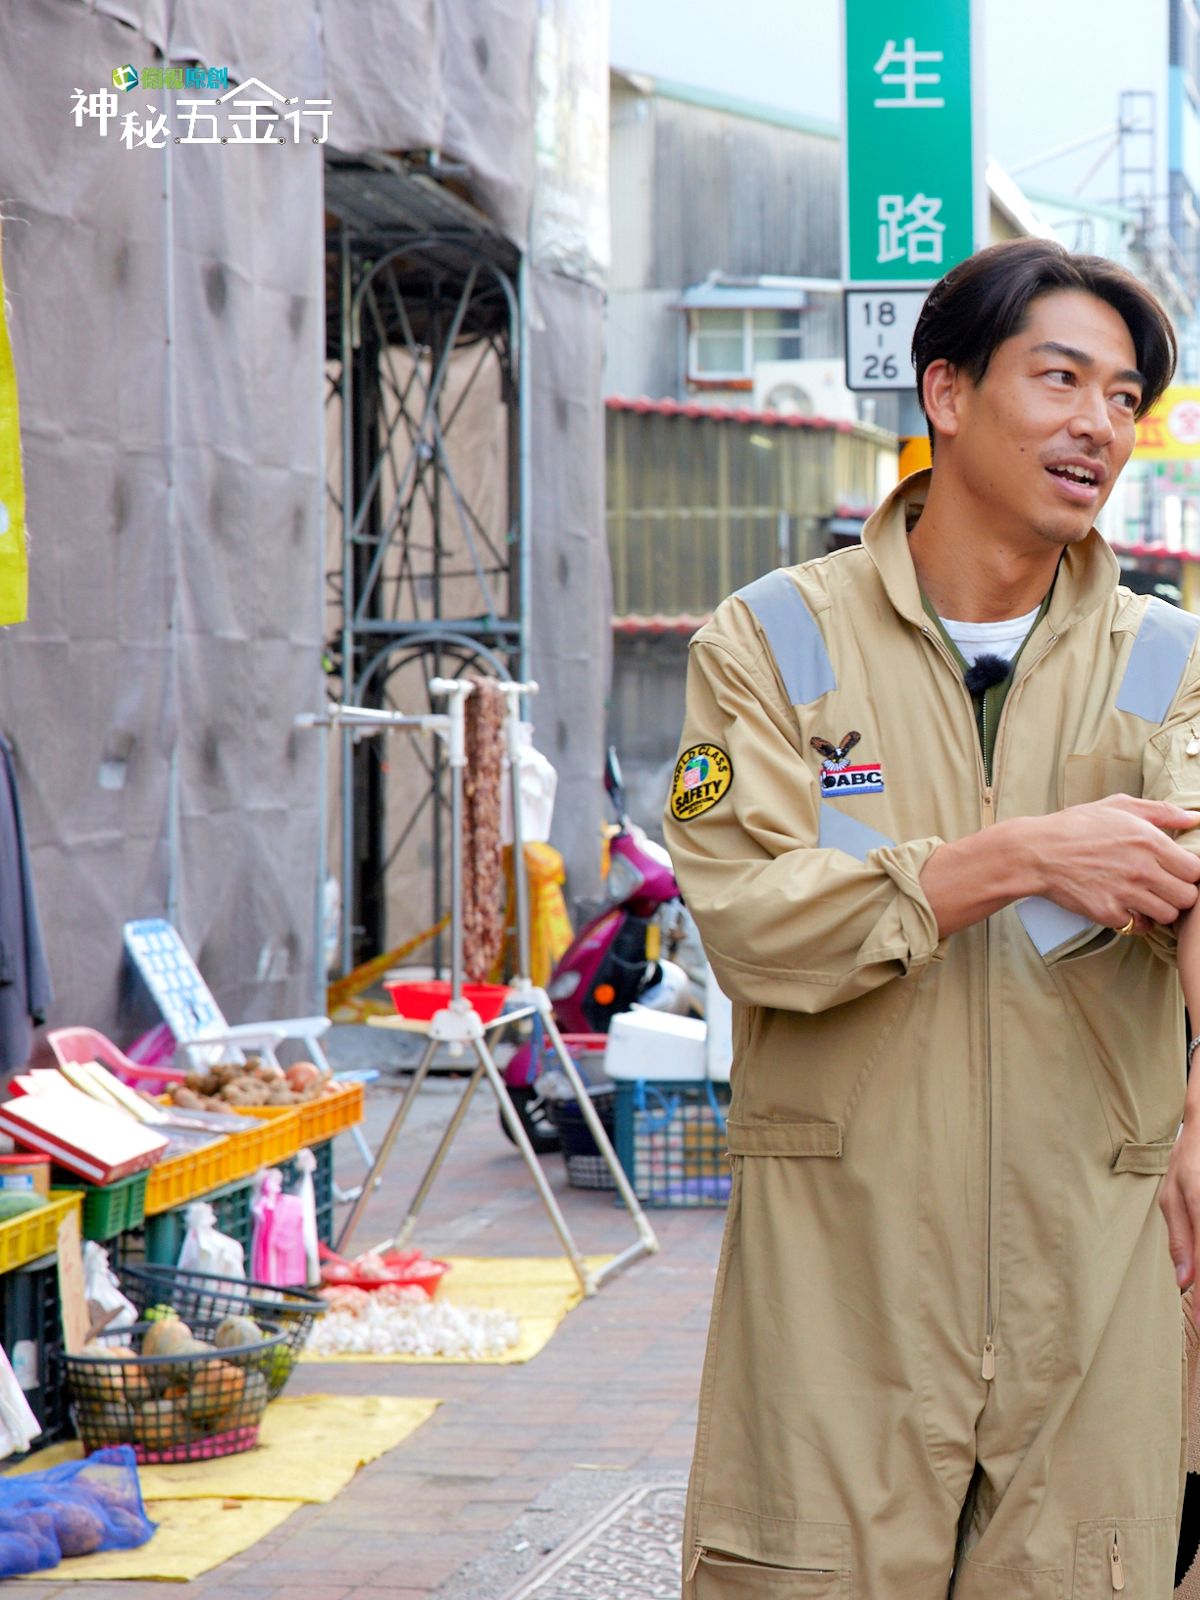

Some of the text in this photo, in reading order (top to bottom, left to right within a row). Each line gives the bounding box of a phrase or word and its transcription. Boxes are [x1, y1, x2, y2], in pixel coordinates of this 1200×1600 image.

[873, 37, 946, 264] 生路
[864, 302, 896, 326] 18
[864, 355, 898, 380] 26
[698, 746, 728, 773] CLASS
[676, 779, 723, 812] SAFETY
